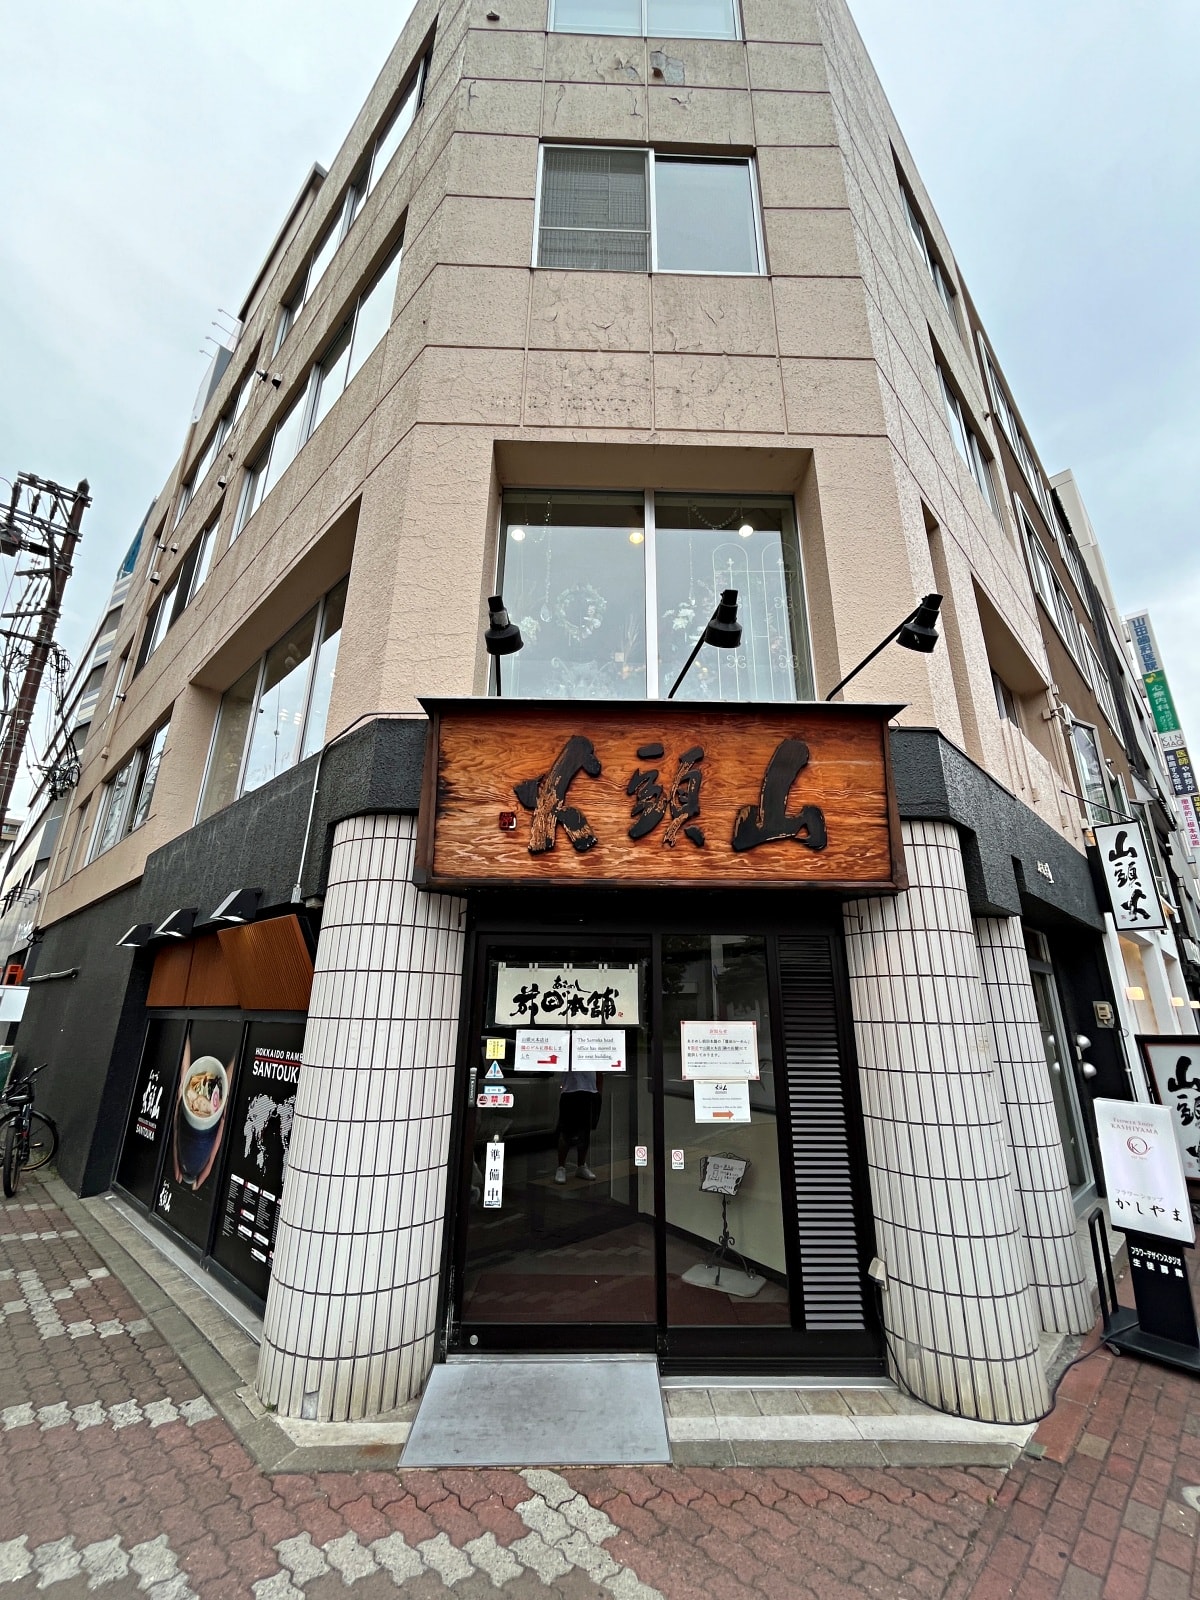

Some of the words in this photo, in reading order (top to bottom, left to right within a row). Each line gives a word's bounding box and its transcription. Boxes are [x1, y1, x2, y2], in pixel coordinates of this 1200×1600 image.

[1132, 618, 1158, 672] 山田歯科医院
[1152, 685, 1169, 711] 心療内科
[1109, 831, 1151, 921] 山頭火
[510, 983, 619, 1020] 前田本舗
[255, 1047, 285, 1060] HOKKAIDO
[253, 1060, 300, 1084] SANTOUK
[1110, 1122, 1159, 1136] KASHIYAMA
[1116, 1198, 1182, 1222] かしやま
